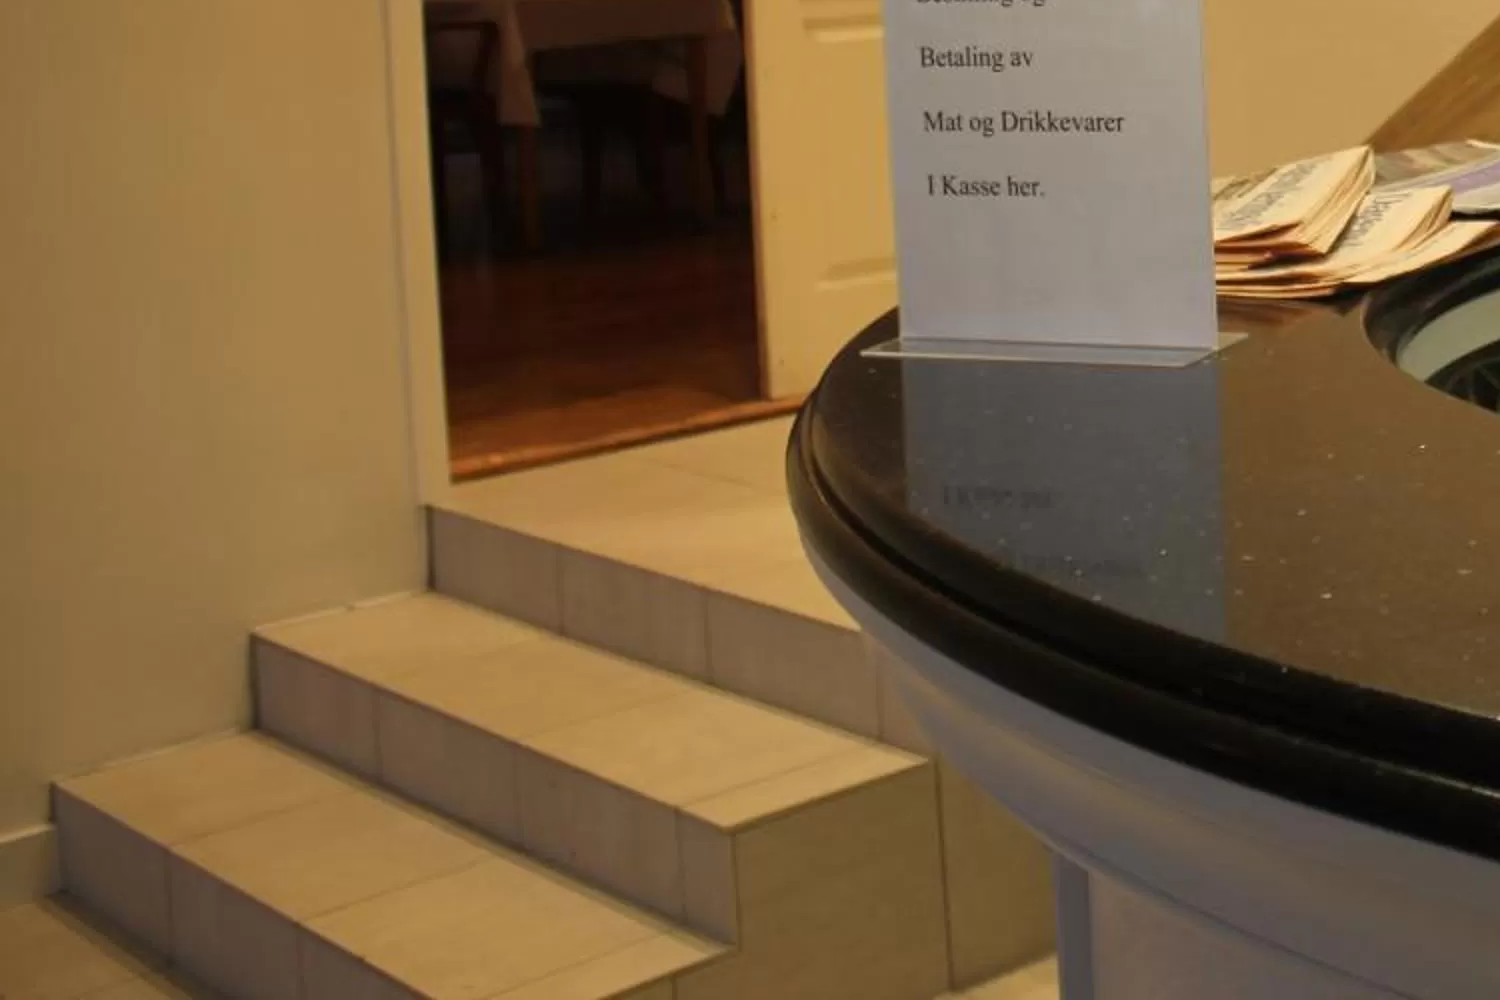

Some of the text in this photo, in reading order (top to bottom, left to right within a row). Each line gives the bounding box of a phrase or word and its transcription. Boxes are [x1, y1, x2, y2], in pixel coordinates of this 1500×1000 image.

[919, 46, 1034, 72] Betaling av
[923, 110, 1125, 138] Mat og Drikkevarer
[927, 174, 1046, 198] I Kasse her.
